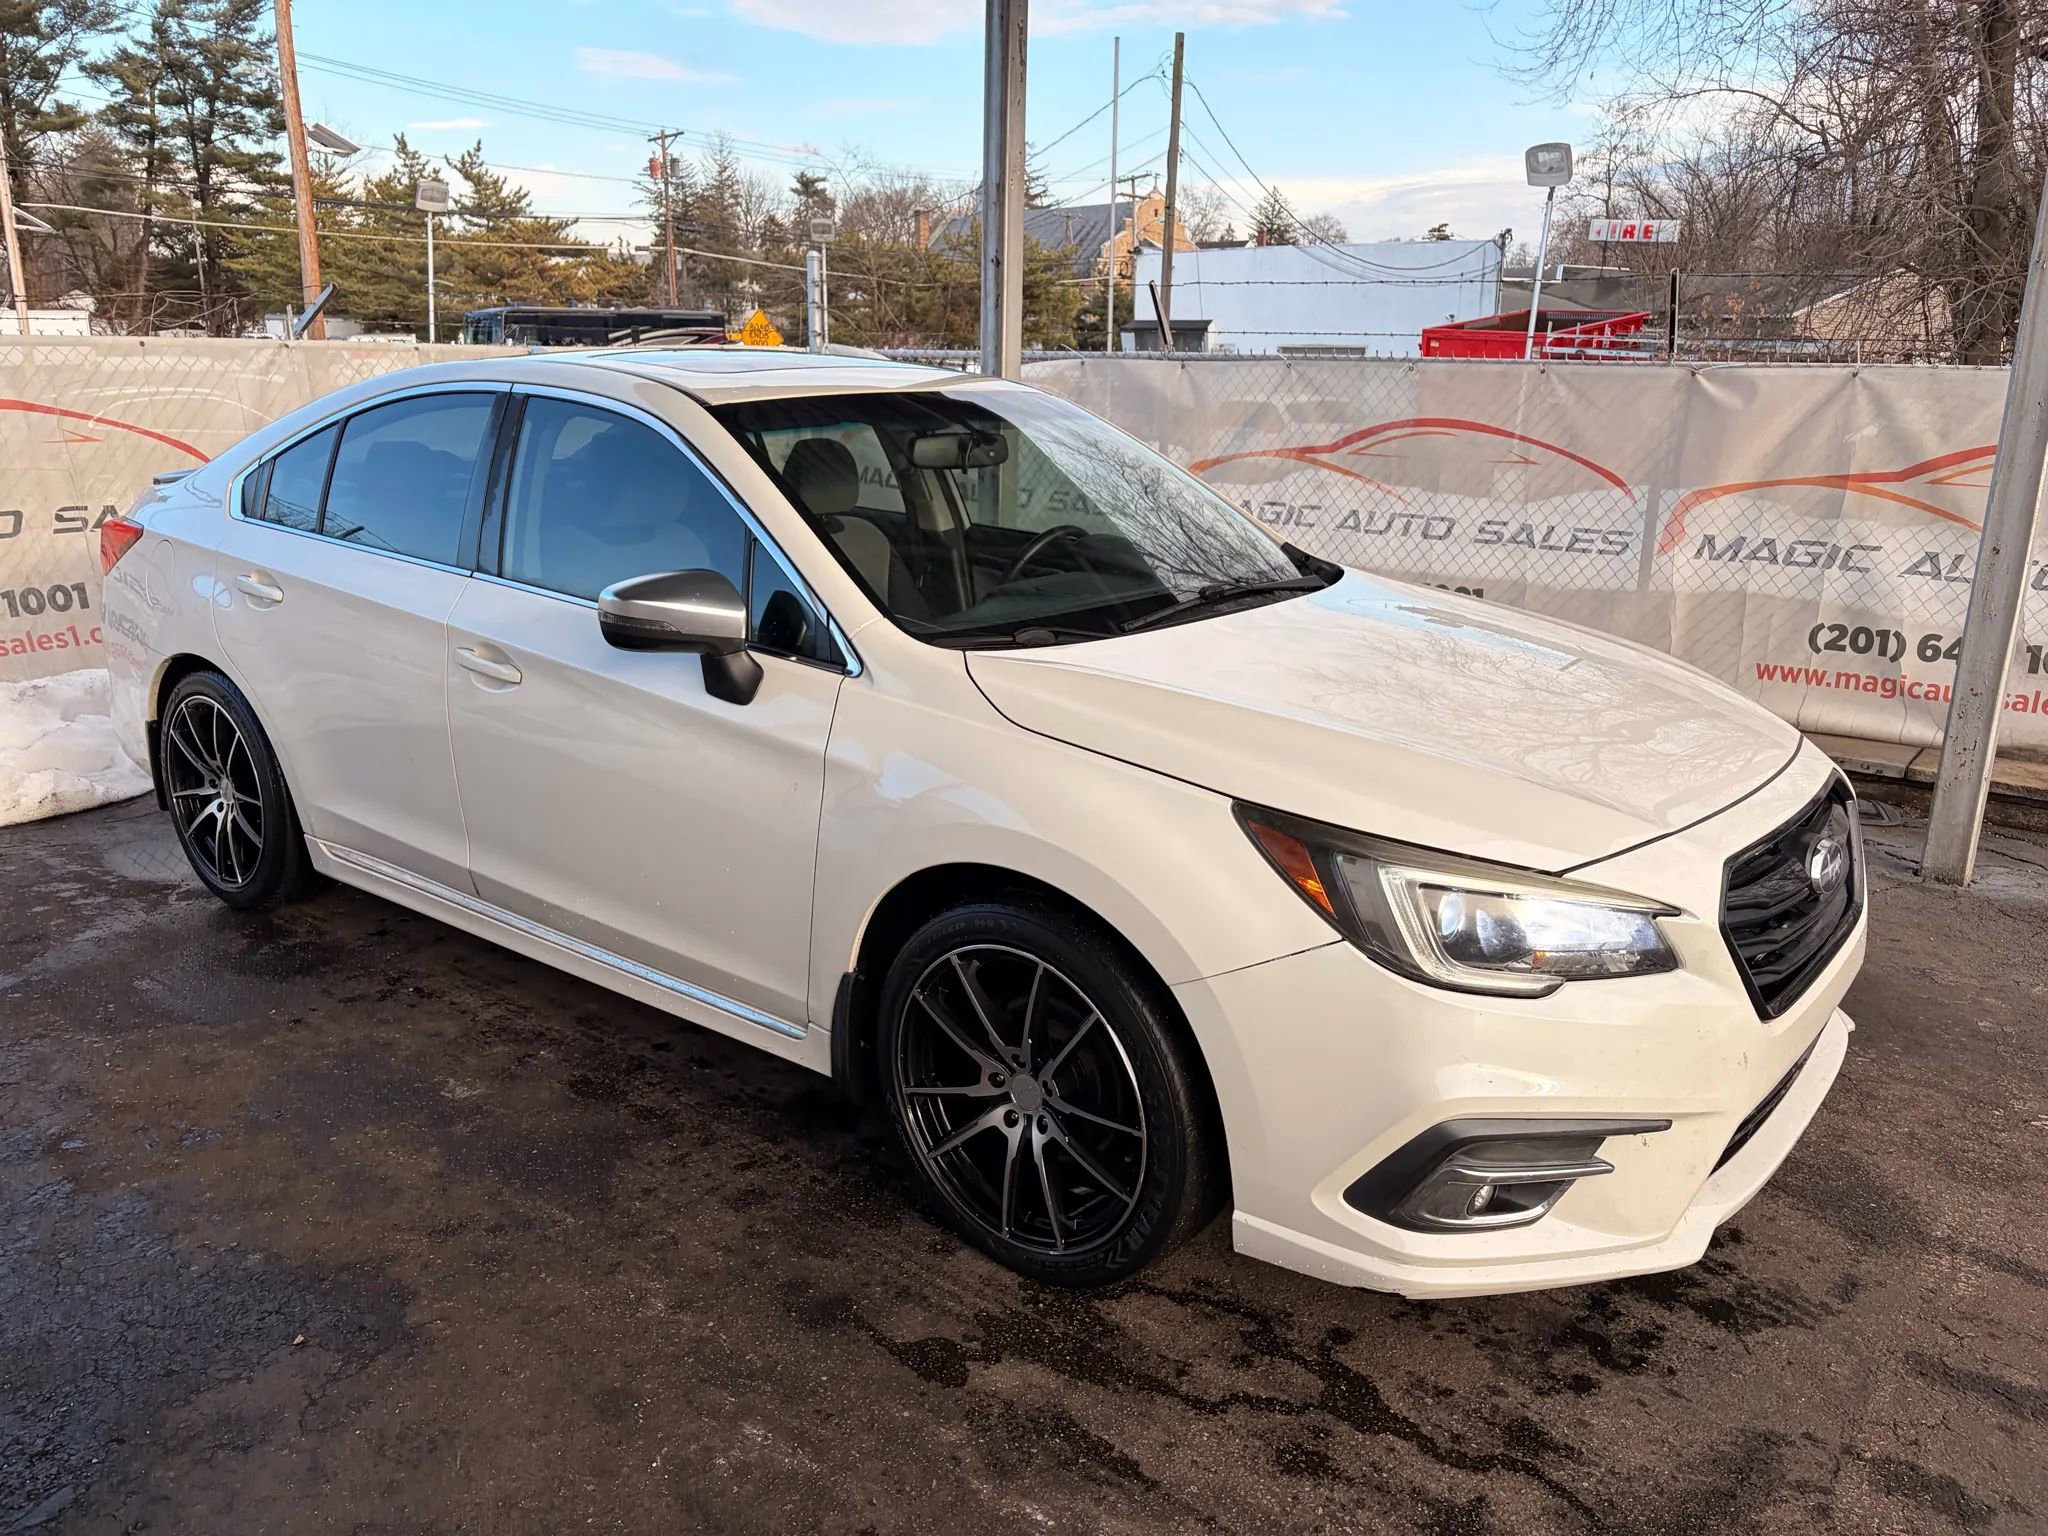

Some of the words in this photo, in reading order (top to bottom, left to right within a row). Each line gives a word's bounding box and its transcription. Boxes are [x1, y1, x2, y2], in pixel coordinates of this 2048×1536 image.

[1595, 224, 1654, 239] IRE
[1333, 509, 1456, 541] AUTO
[1473, 520, 1634, 556] SALES
[1693, 534, 1883, 574] MAGIC
[0, 582, 90, 618] 1001
[1808, 622, 1907, 663] (201)
